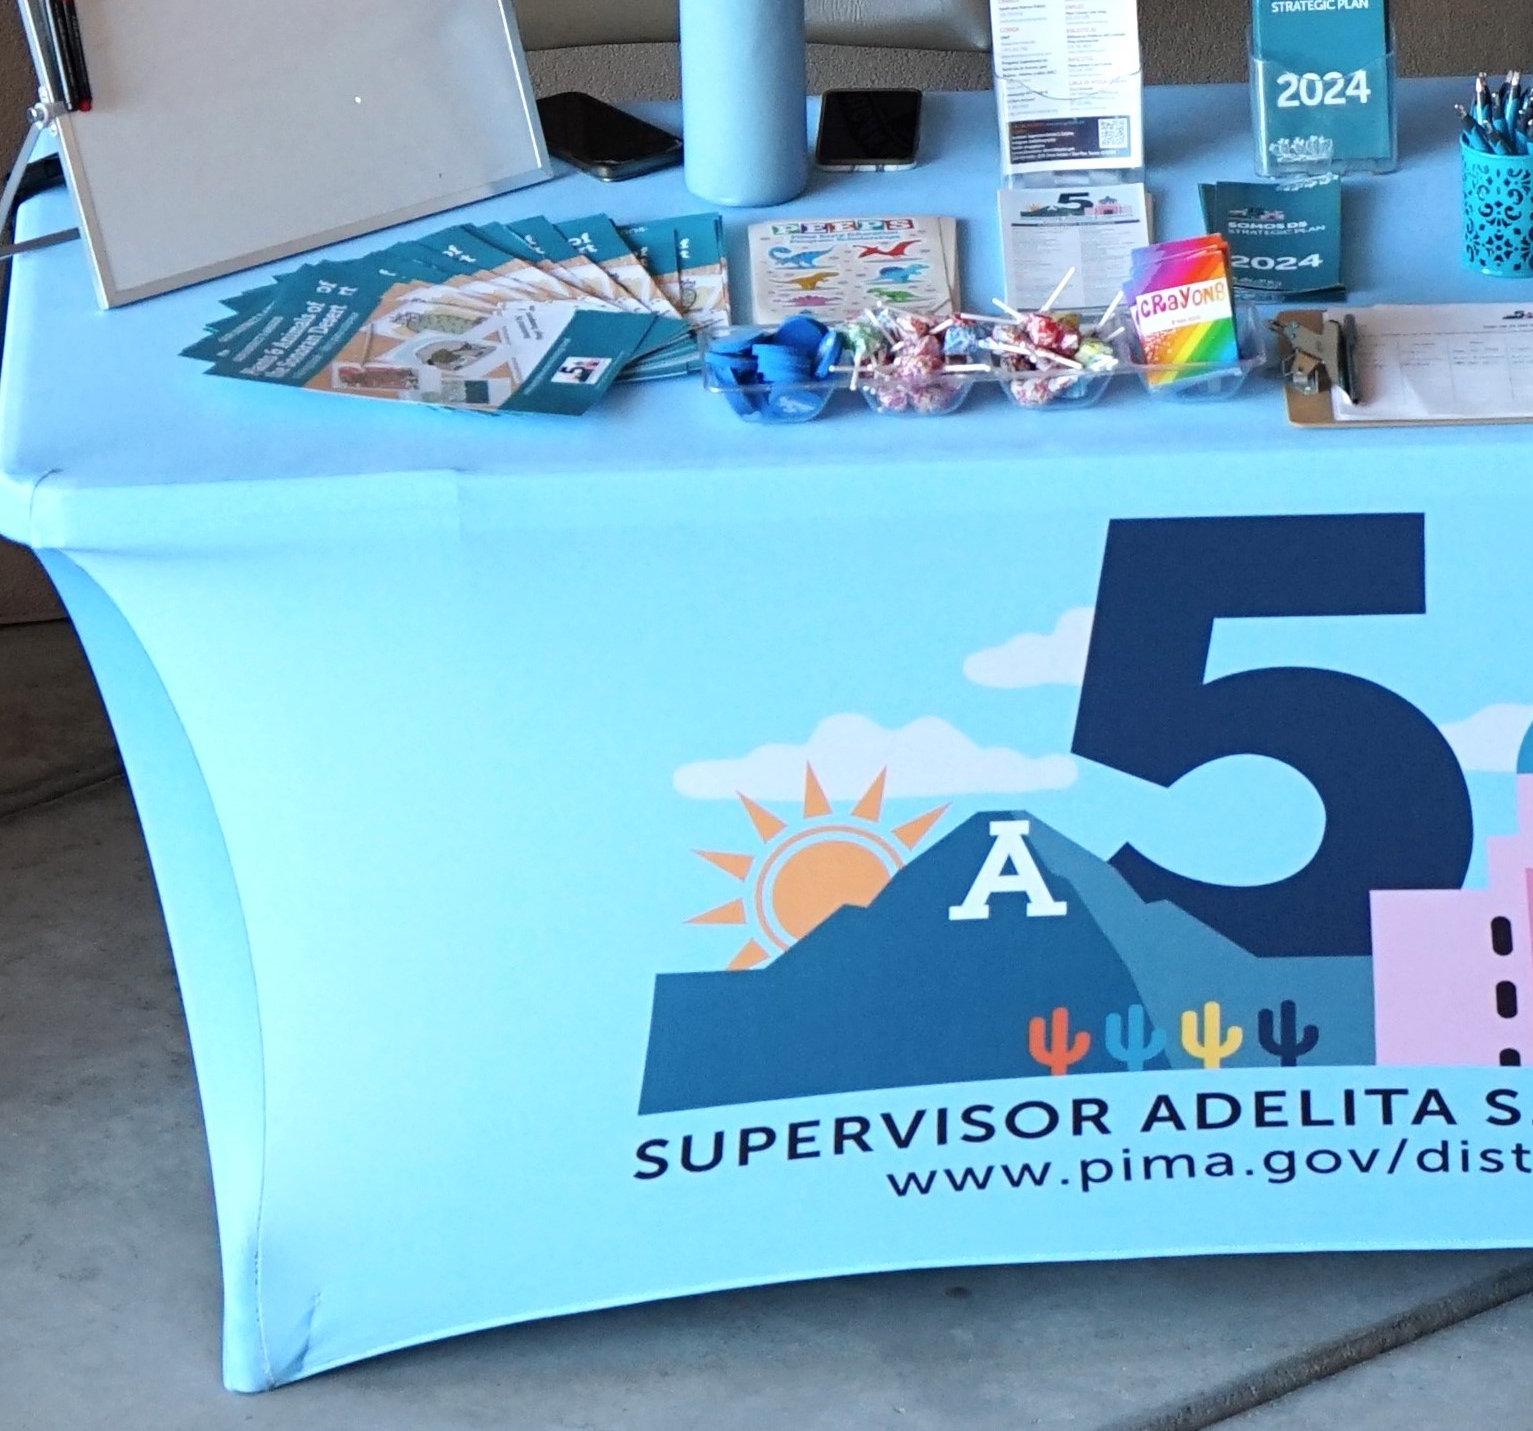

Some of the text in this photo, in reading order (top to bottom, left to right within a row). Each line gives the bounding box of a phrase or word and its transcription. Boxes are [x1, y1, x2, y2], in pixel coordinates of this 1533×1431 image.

[1270, 0, 1336, 13] STRATEGIC
[1276, 68, 1372, 108] 2024
[1057, 192, 1094, 215] 5
[772, 218, 914, 236] PEEPS
[1228, 222, 1285, 230] SOMOS
[1294, 224, 1326, 234] PLAN
[1230, 253, 1324, 271] 2024
[306, 300, 325, 316] of
[312, 304, 348, 341] Desert
[1070, 510, 1475, 958] 5
[947, 819, 1069, 921] A
[633, 1096, 1112, 1180] SUPERVISOR
[1141, 1086, 1458, 1133] ADELITA
